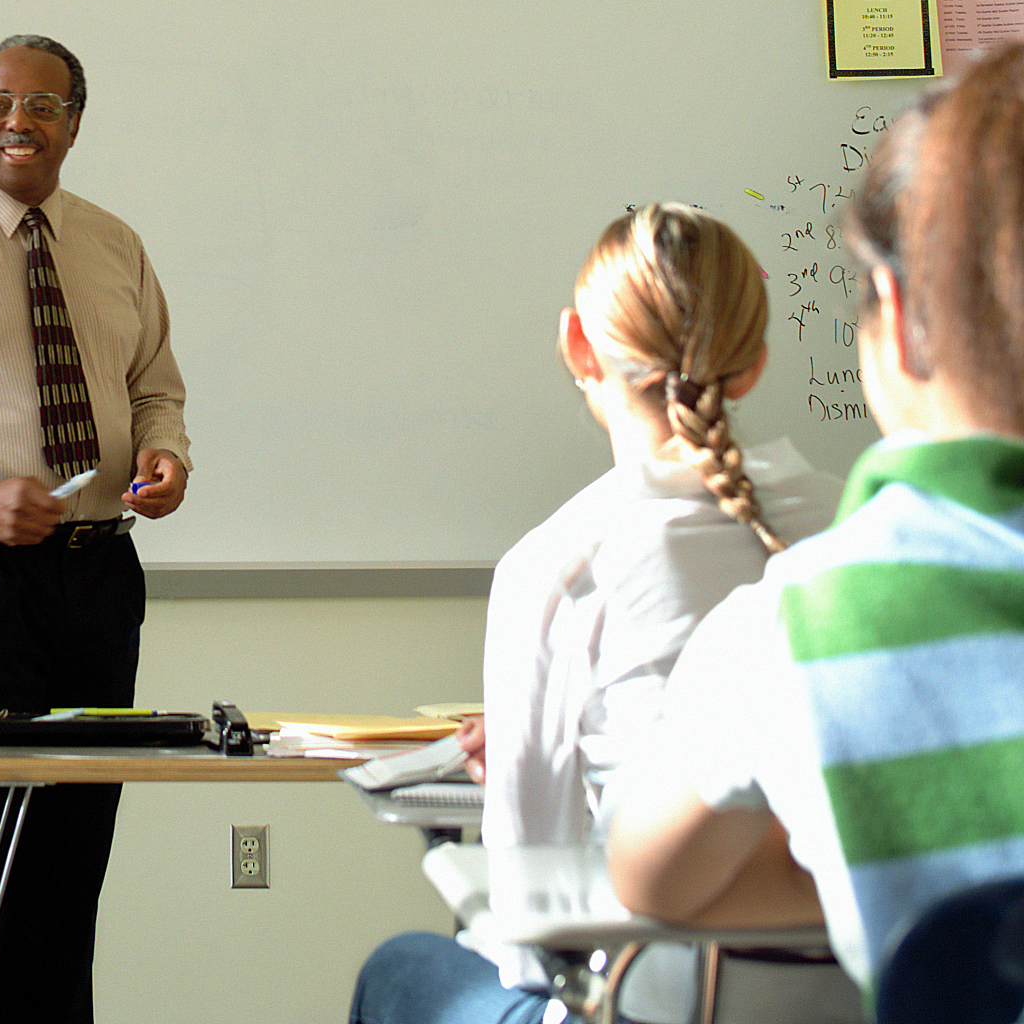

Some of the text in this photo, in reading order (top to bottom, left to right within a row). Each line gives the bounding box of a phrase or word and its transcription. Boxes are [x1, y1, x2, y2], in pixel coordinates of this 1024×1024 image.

[851, 105, 893, 135] Ea
[840, 143, 871, 172] Di
[781, 222, 815, 251] 2nd
[809, 356, 863, 385] Lunc
[808, 390, 867, 422] Dismi
